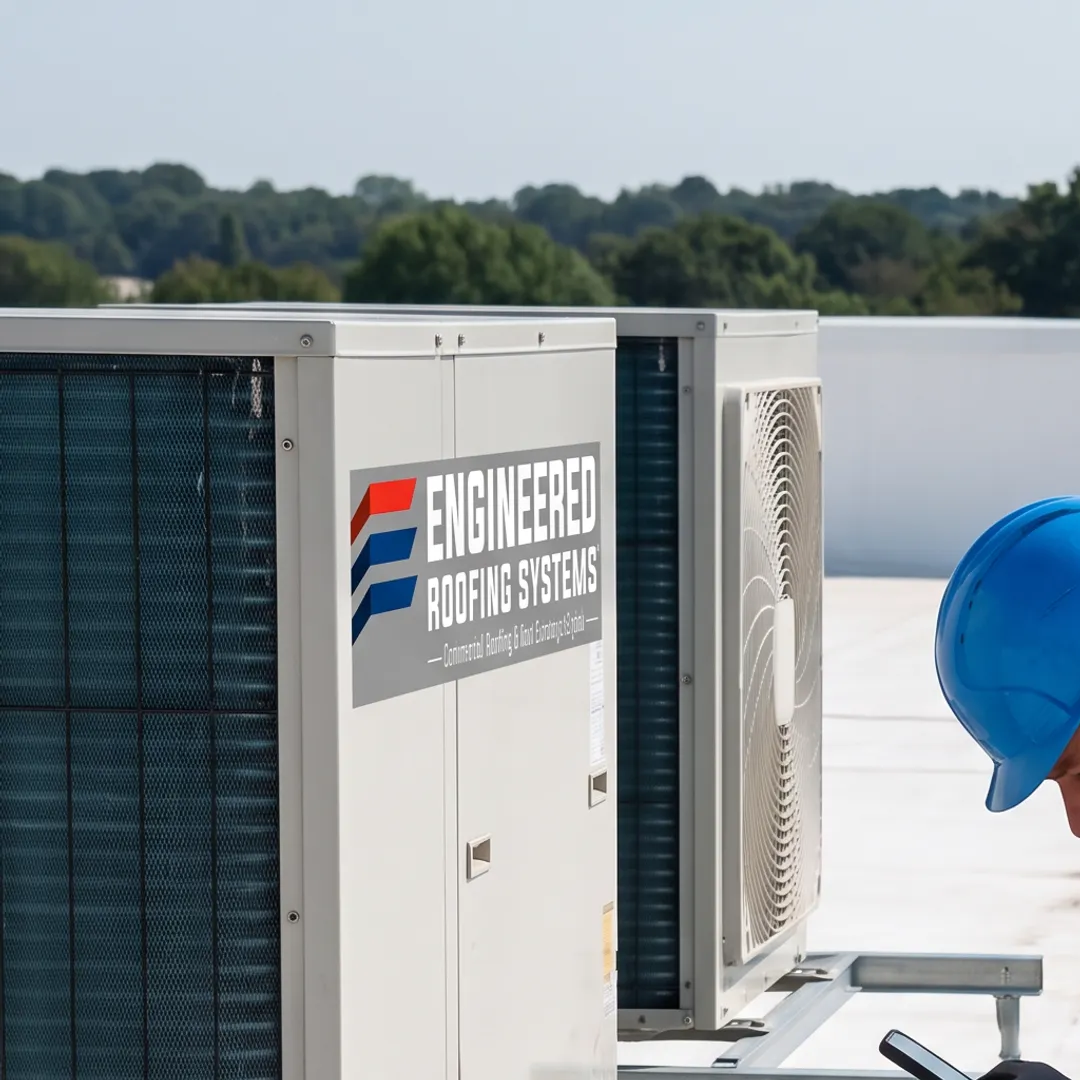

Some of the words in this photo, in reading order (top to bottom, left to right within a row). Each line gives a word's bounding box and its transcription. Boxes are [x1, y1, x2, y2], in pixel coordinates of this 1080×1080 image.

[426, 456, 596, 563] ENGINEERED
[427, 563, 512, 632] ROOFING
[518, 545, 597, 610] SYSTEMS
